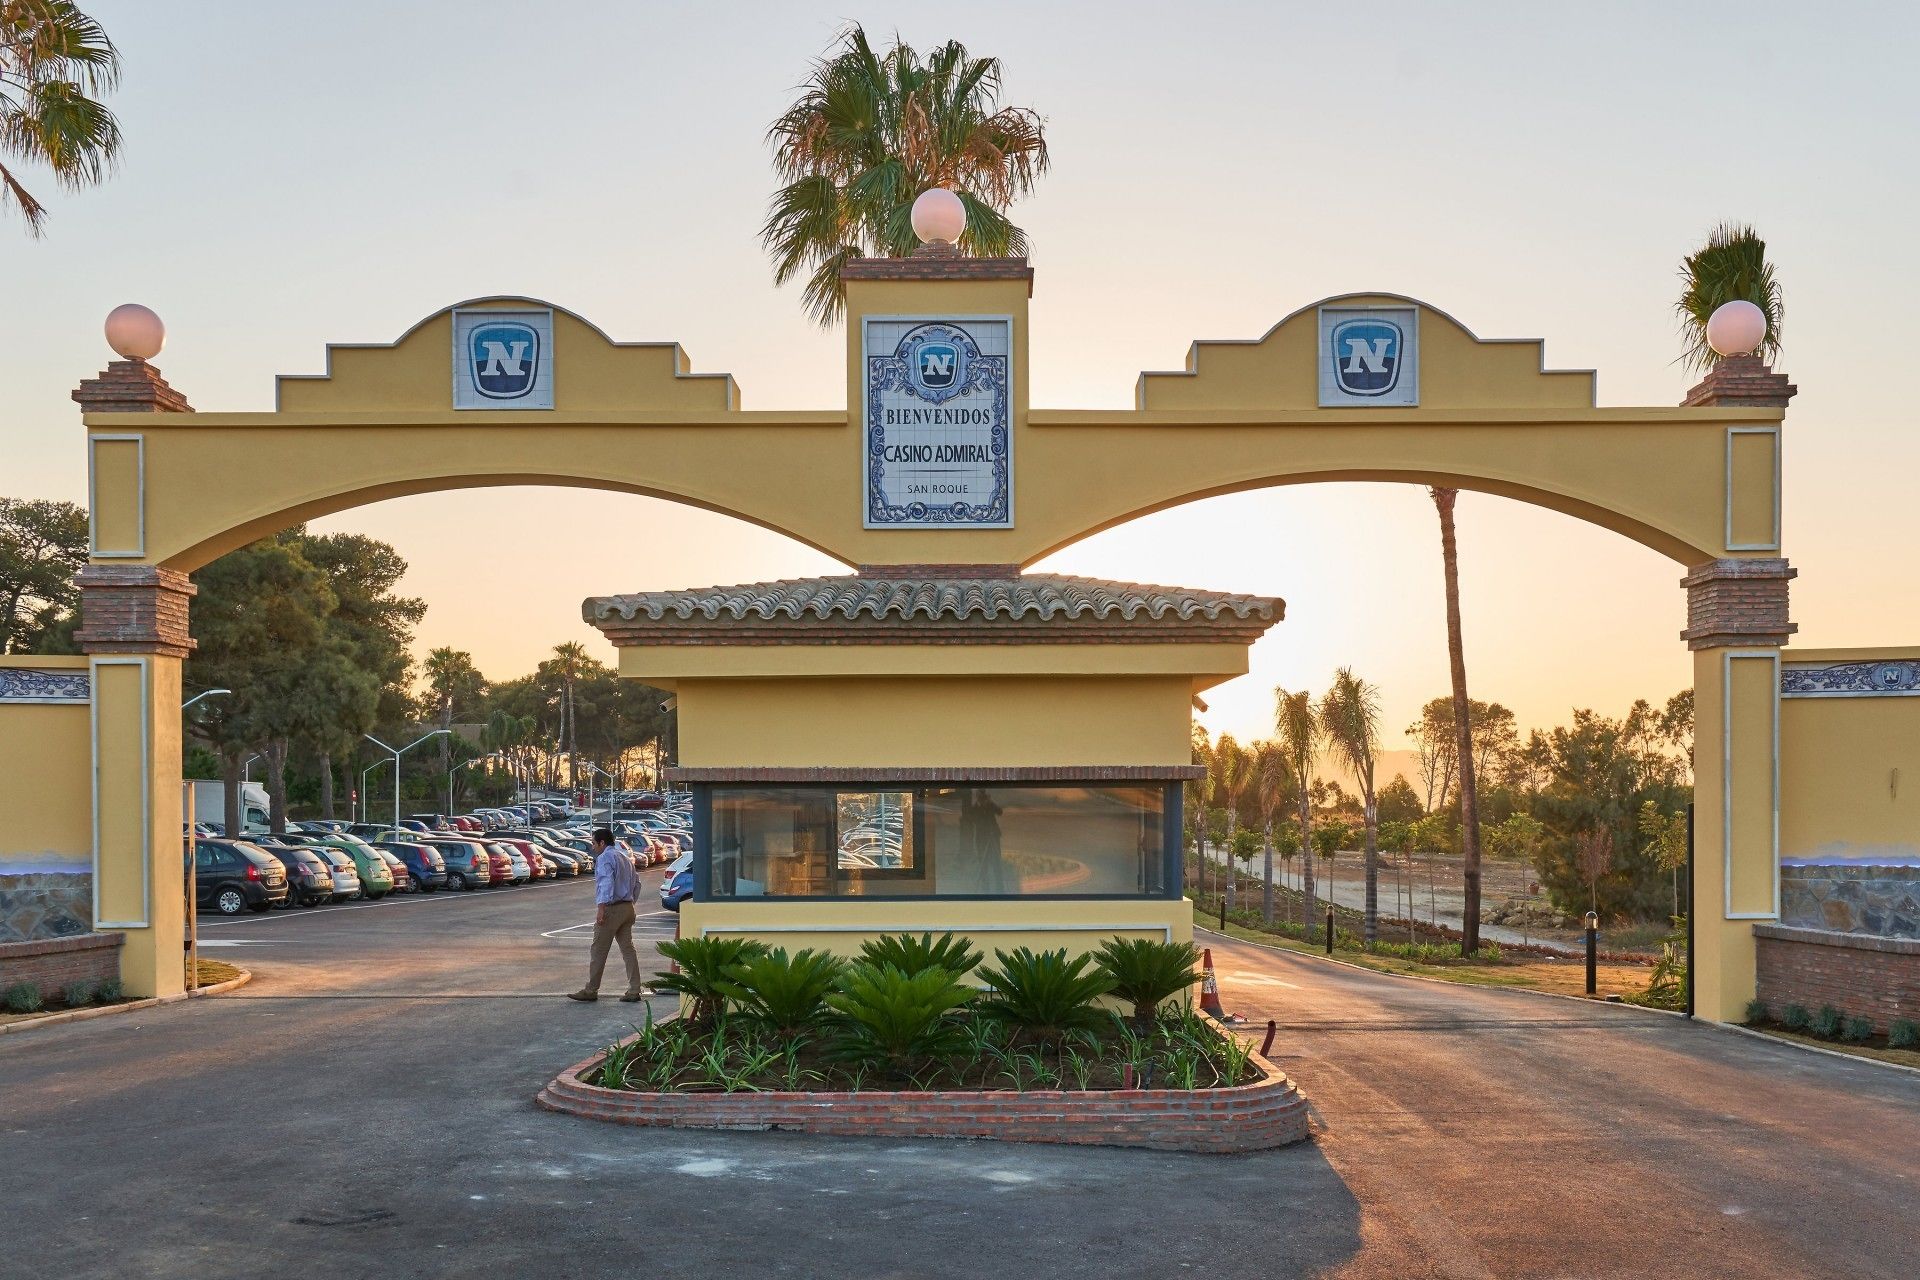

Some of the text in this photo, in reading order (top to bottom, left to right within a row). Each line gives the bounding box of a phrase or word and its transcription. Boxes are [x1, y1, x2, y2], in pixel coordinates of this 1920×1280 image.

[480, 341, 529, 376] N
[924, 354, 952, 375] N
[1343, 338, 1393, 373] N
[886, 408, 990, 425] BIENVENIDOS
[884, 445, 993, 463] CASINO ADMIRAL
[907, 484, 969, 494] SAN ROQUE
